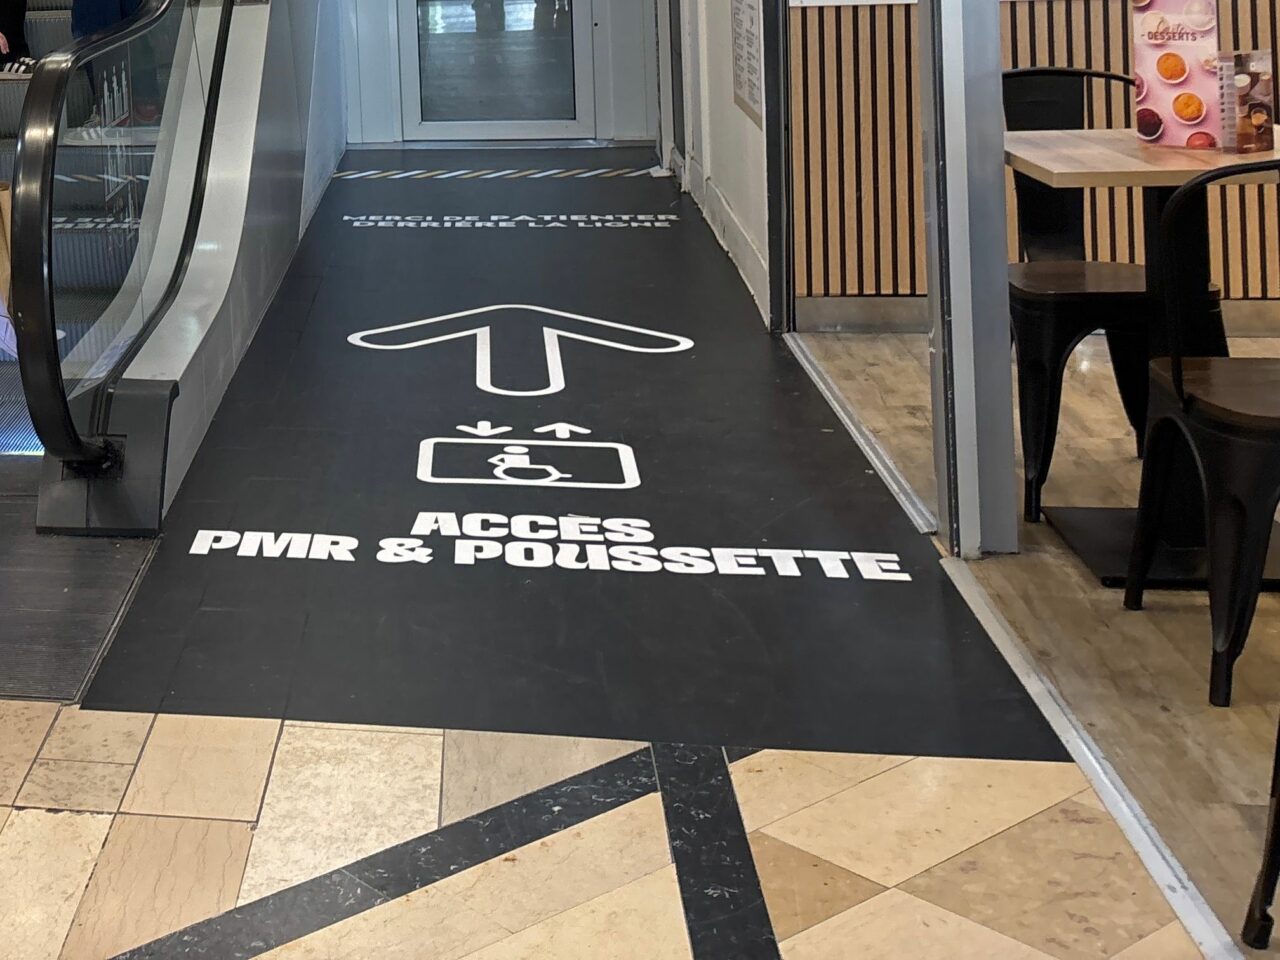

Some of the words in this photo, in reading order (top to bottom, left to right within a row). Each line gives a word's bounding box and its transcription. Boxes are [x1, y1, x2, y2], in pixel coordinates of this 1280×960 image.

[1147, 31, 1197, 41] DESSERTS
[411, 512, 655, 542] ACCÈS
[189, 529, 360, 562] PMR
[376, 537, 434, 564] &
[454, 540, 913, 581] POUSSETTE
